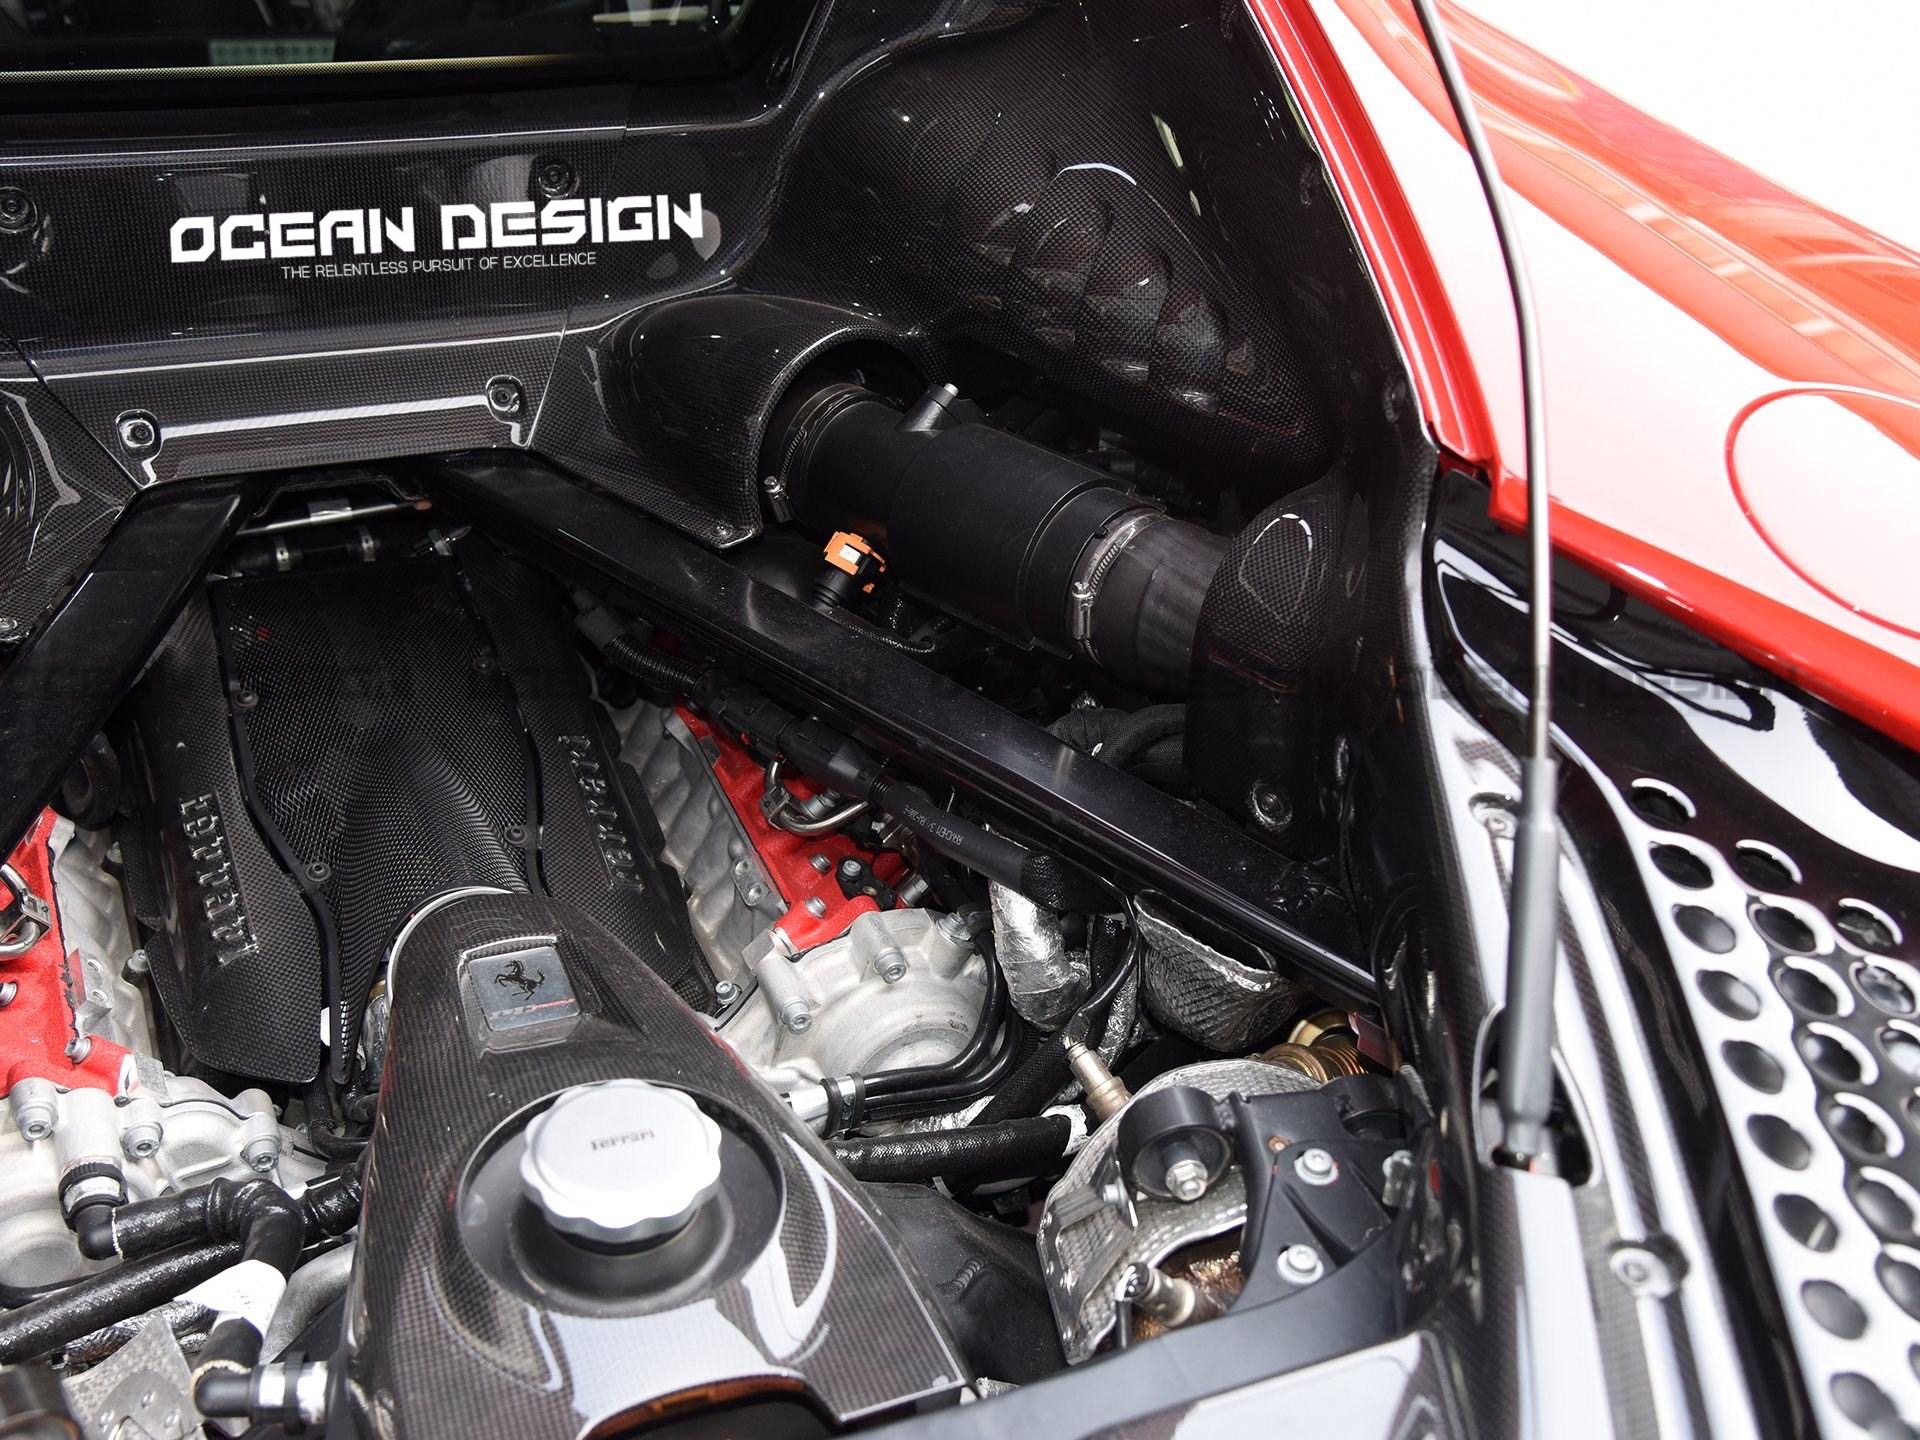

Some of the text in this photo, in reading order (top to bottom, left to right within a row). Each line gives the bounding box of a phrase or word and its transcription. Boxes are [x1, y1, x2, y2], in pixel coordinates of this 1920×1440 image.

[170, 193, 704, 263] OCEAN DESIGN
[281, 252, 597, 279] THE RELENTLESS PURSUIT OF EXCELLENCE
